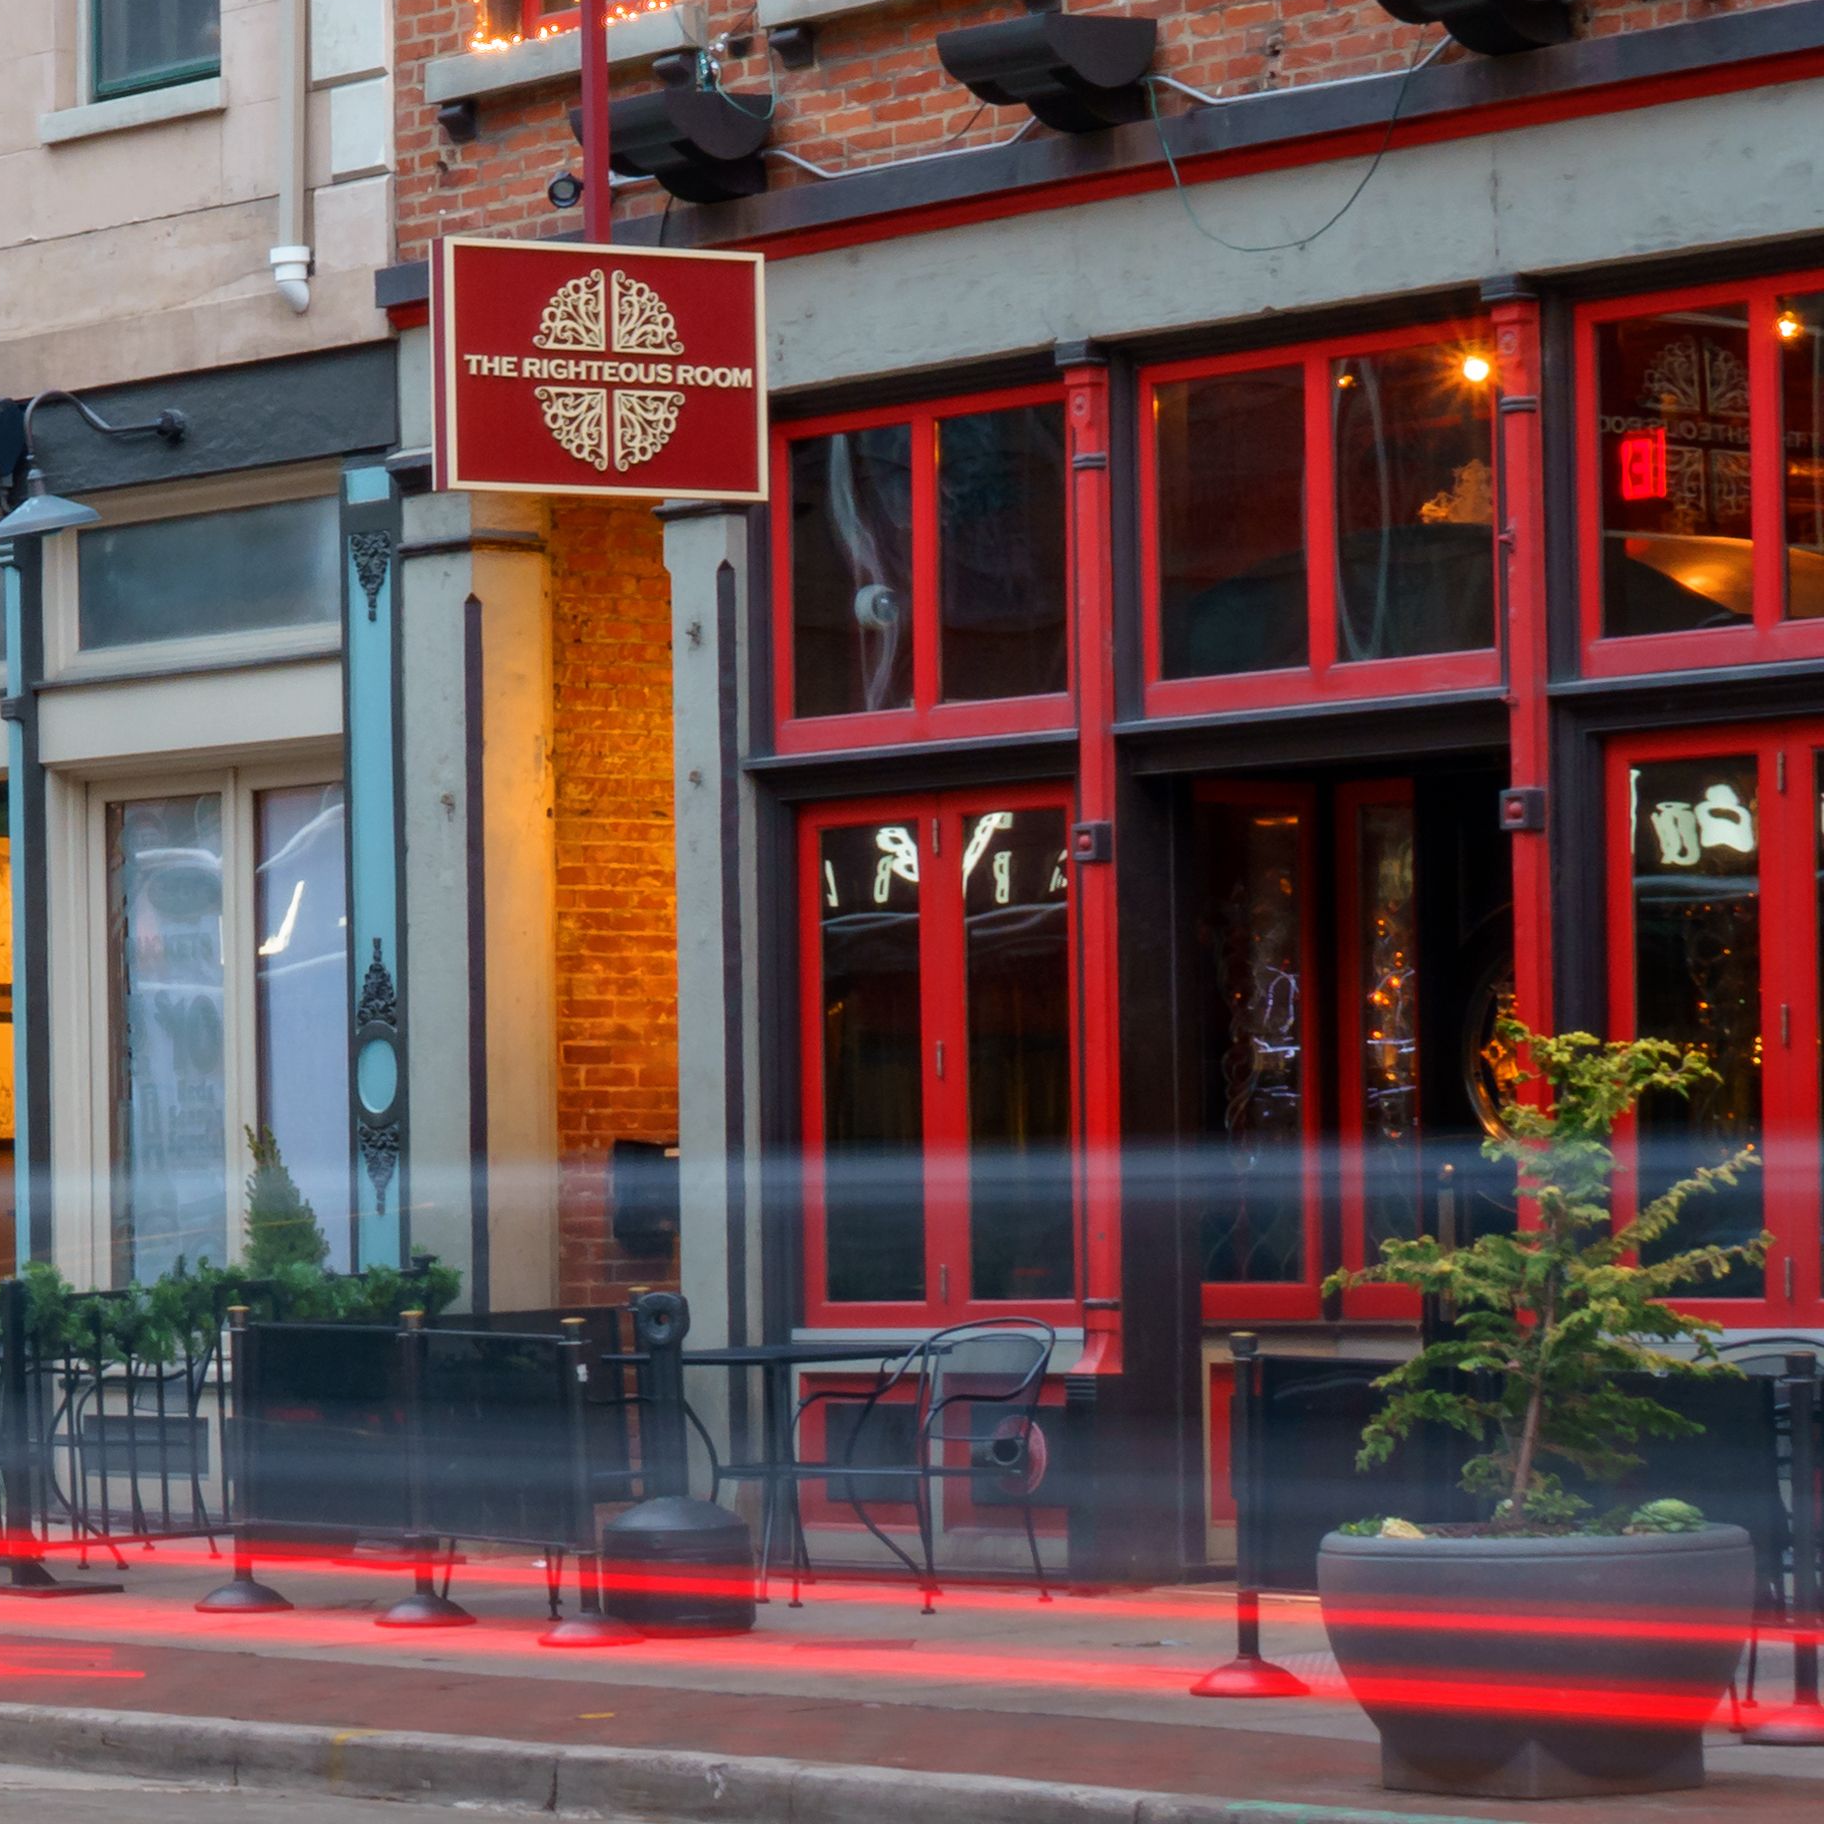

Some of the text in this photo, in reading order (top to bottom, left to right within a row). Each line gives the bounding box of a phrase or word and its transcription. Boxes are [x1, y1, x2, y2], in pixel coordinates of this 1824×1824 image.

[464, 354, 753, 388] THE RIGHTEOUS ROOM
